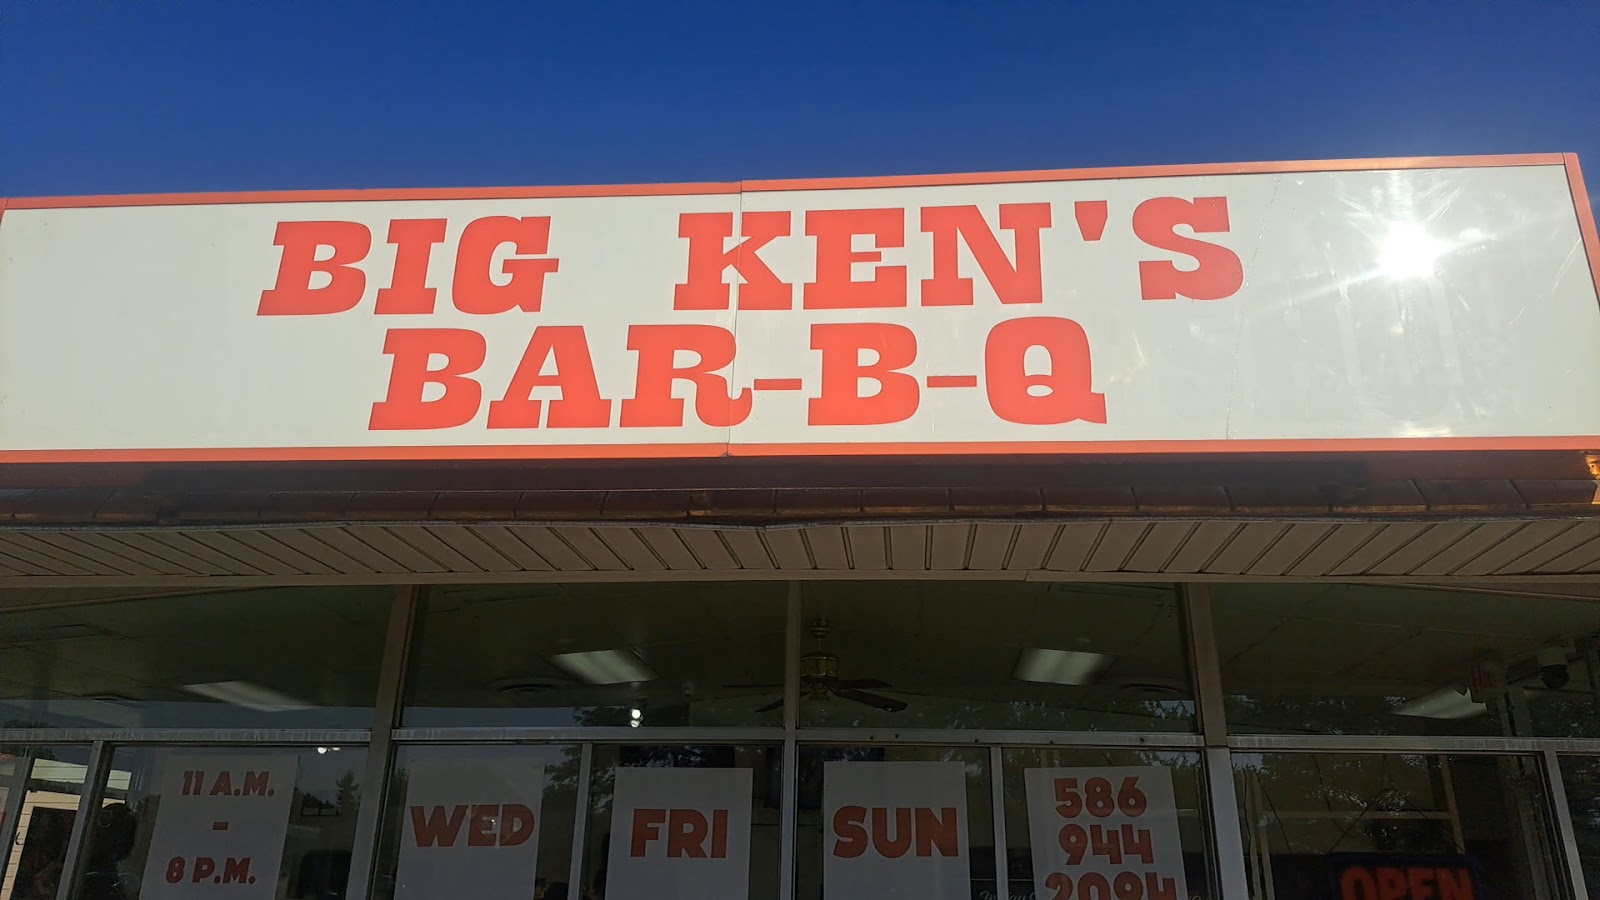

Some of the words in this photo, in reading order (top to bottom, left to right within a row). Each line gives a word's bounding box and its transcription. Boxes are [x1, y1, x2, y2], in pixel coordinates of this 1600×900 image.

[257, 215, 560, 316] BIG
[673, 196, 1243, 311] KEN'S
[368, 316, 1107, 431] BAR-B-Q
[181, 770, 205, 796] 11
[209, 770, 275, 796] A.M.
[1054, 777, 1148, 819] 586
[410, 803, 536, 848] WED
[630, 808, 729, 859] FRI
[832, 805, 960, 860] SUN
[1058, 823, 1154, 865] 944
[165, 856, 186, 884] 8
[192, 856, 256, 884] P.M.
[1045, 871, 1178, 900] 2094
[1340, 865, 1476, 900] OPEN
